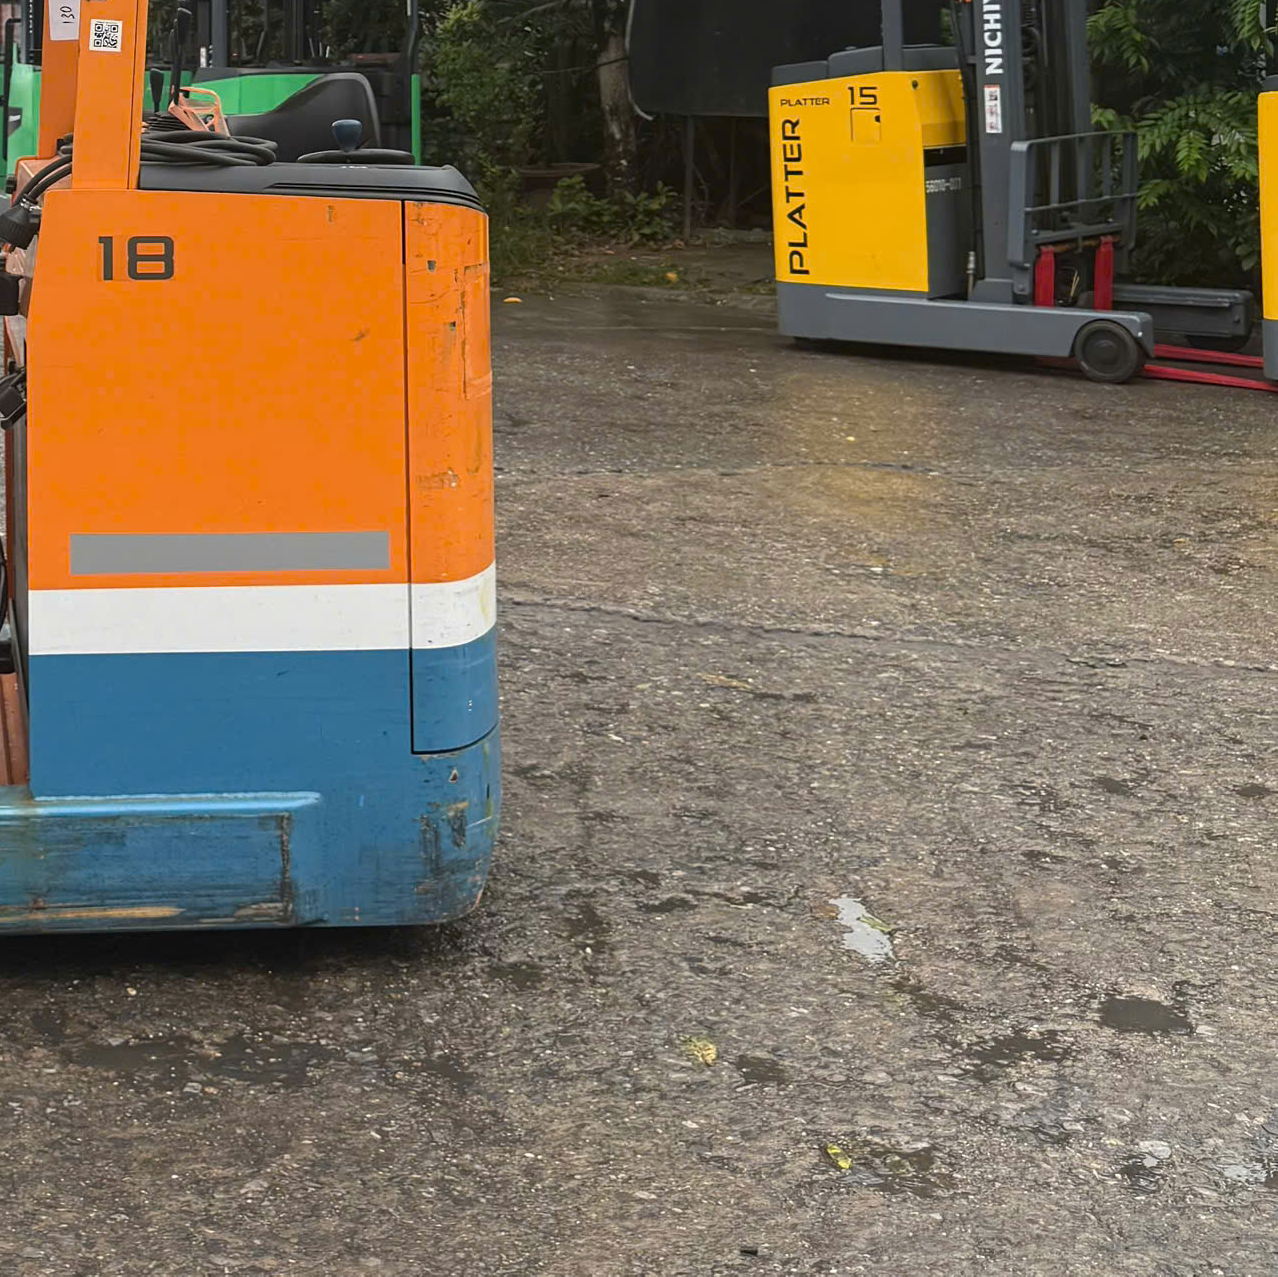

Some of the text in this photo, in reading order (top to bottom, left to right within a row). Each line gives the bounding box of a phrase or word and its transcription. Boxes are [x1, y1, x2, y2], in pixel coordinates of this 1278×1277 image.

[780, 86, 878, 107] PLATTER 15
[781, 118, 811, 275] PLATTER
[98, 236, 174, 281] 18
